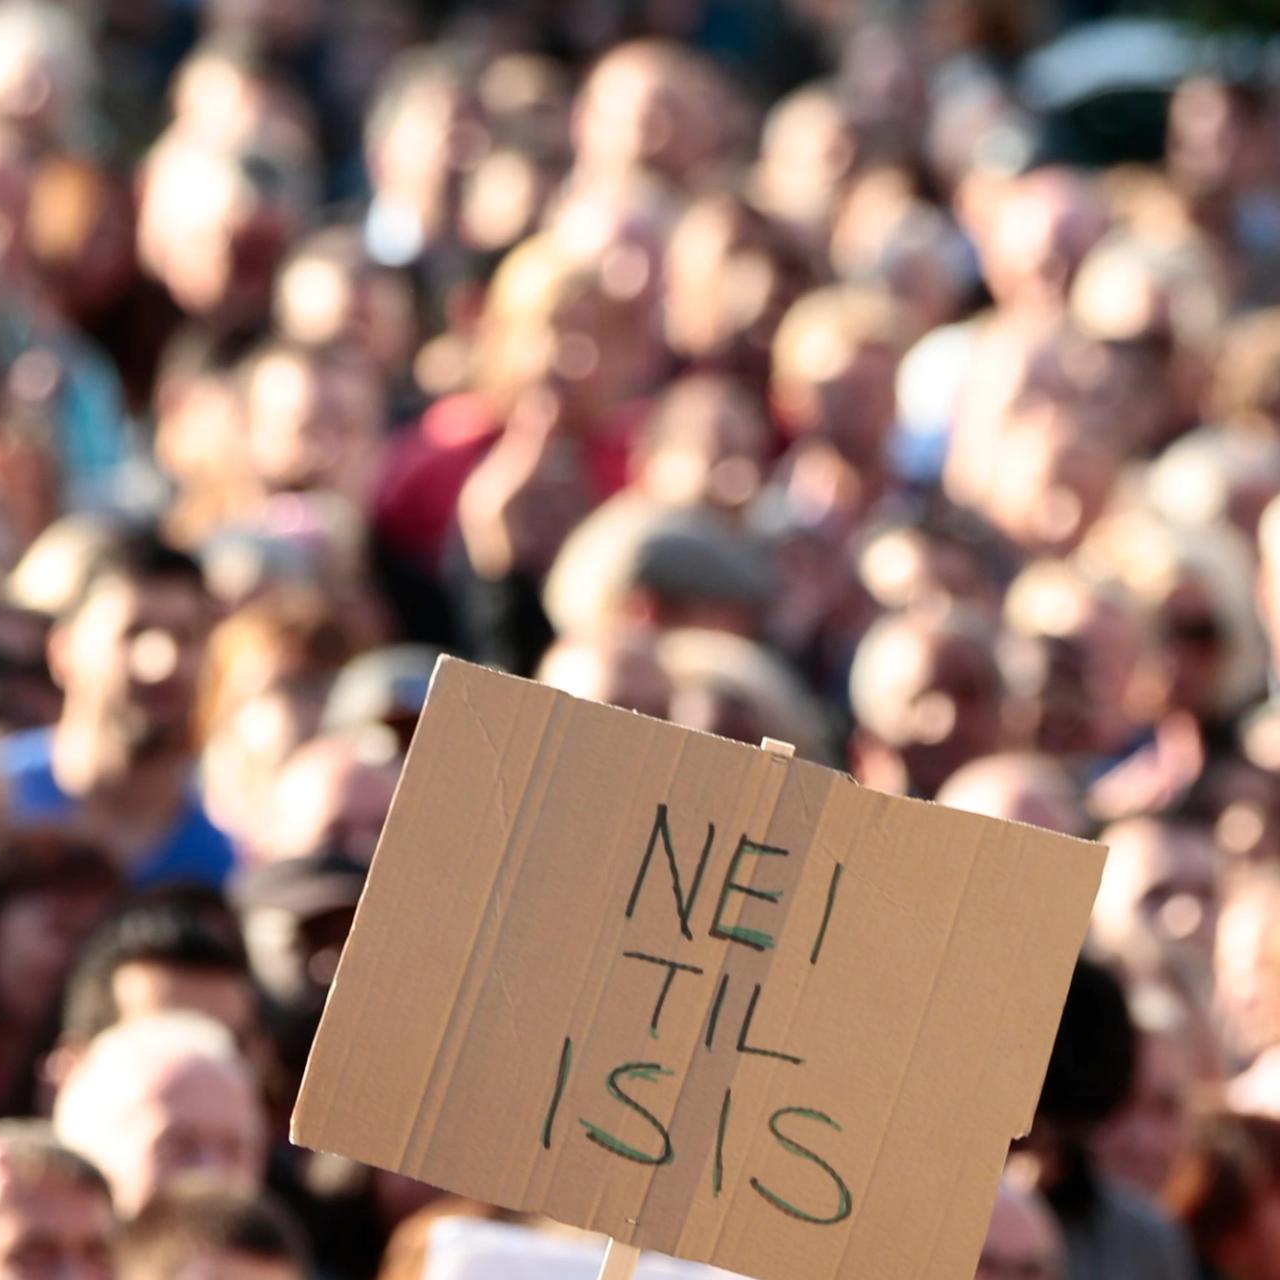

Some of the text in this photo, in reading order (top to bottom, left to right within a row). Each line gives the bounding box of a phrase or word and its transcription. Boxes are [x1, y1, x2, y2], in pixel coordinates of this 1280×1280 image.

[624, 803, 844, 966] NEI
[622, 950, 807, 1065] TIL
[541, 1035, 853, 1226] ISIS
